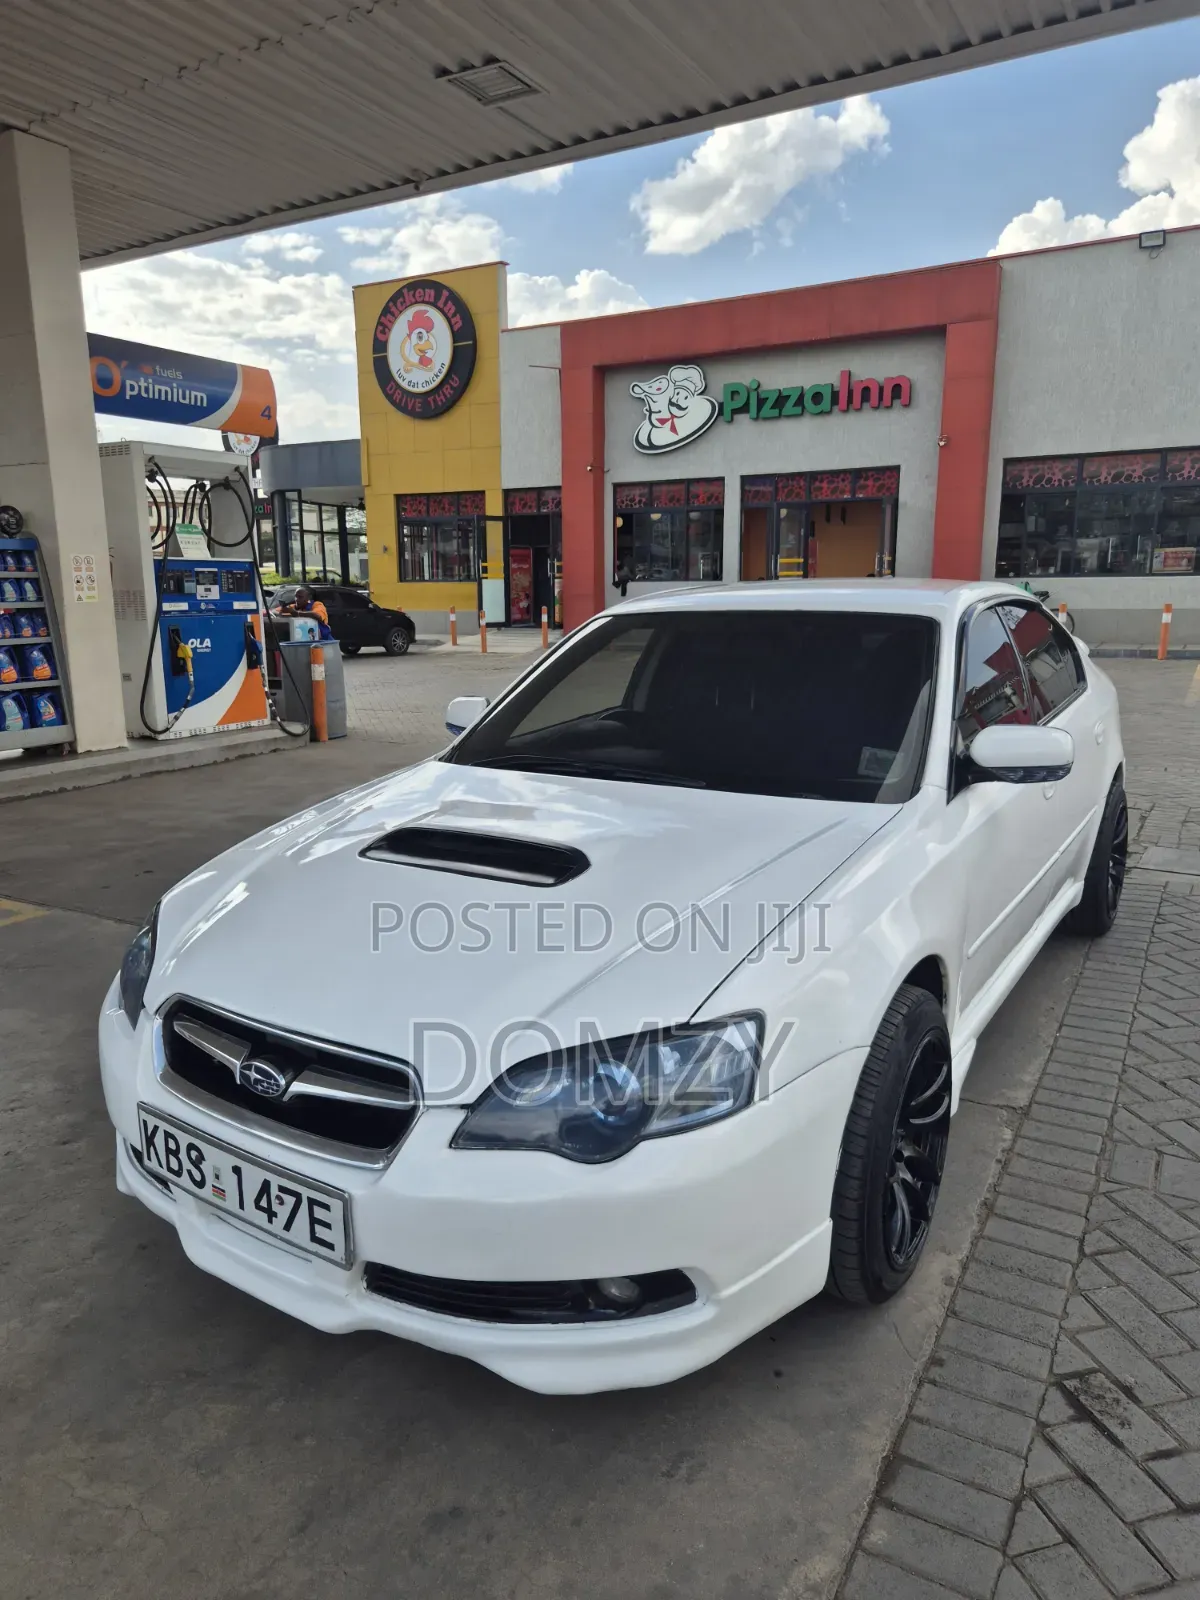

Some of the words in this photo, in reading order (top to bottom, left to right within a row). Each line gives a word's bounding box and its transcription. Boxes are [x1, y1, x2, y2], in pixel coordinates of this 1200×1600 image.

[376, 288, 436, 342] Chicken
[436, 289, 463, 332] Inn
[155, 365, 183, 380] fuels
[396, 368, 406, 382] luv
[407, 379, 419, 388] dat
[421, 362, 446, 388] chicken
[386, 381, 423, 412] DRIVE
[428, 374, 460, 410] THRU
[260, 404, 272, 420] 4
[188, 638, 212, 649] OLA
[142, 1118, 207, 1190] KBS
[231, 1164, 336, 1253] 147E
